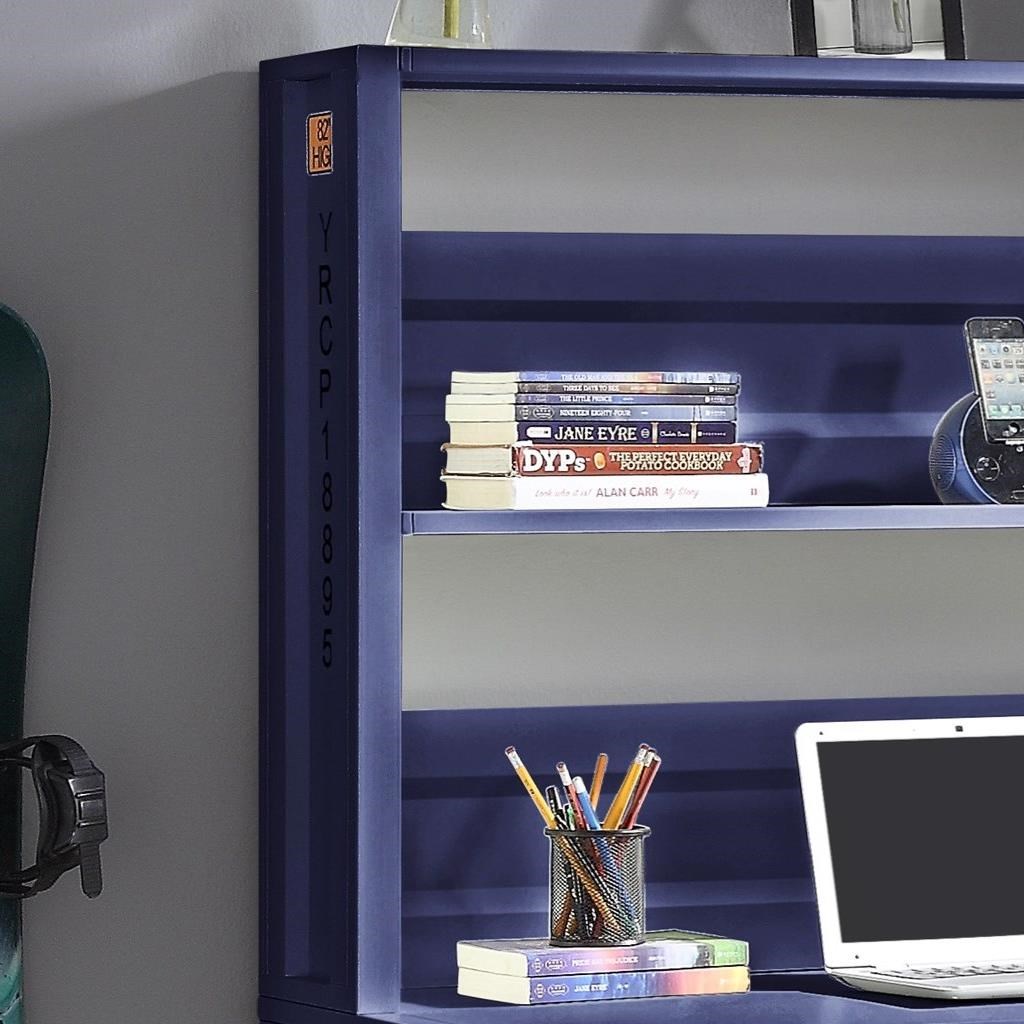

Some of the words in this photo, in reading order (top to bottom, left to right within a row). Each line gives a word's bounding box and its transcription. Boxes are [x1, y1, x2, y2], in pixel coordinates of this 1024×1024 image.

[554, 426, 595, 440] JANE
[597, 425, 638, 440] EYRE
[609, 452, 631, 461] THE
[632, 452, 677, 461] PERFECT
[679, 451, 733, 461] EVERYDAY
[620, 461, 662, 470] POTATO
[664, 461, 724, 470] COOKBOOK
[596, 488, 627, 497] ALAN
[629, 487, 659, 497] CARR
